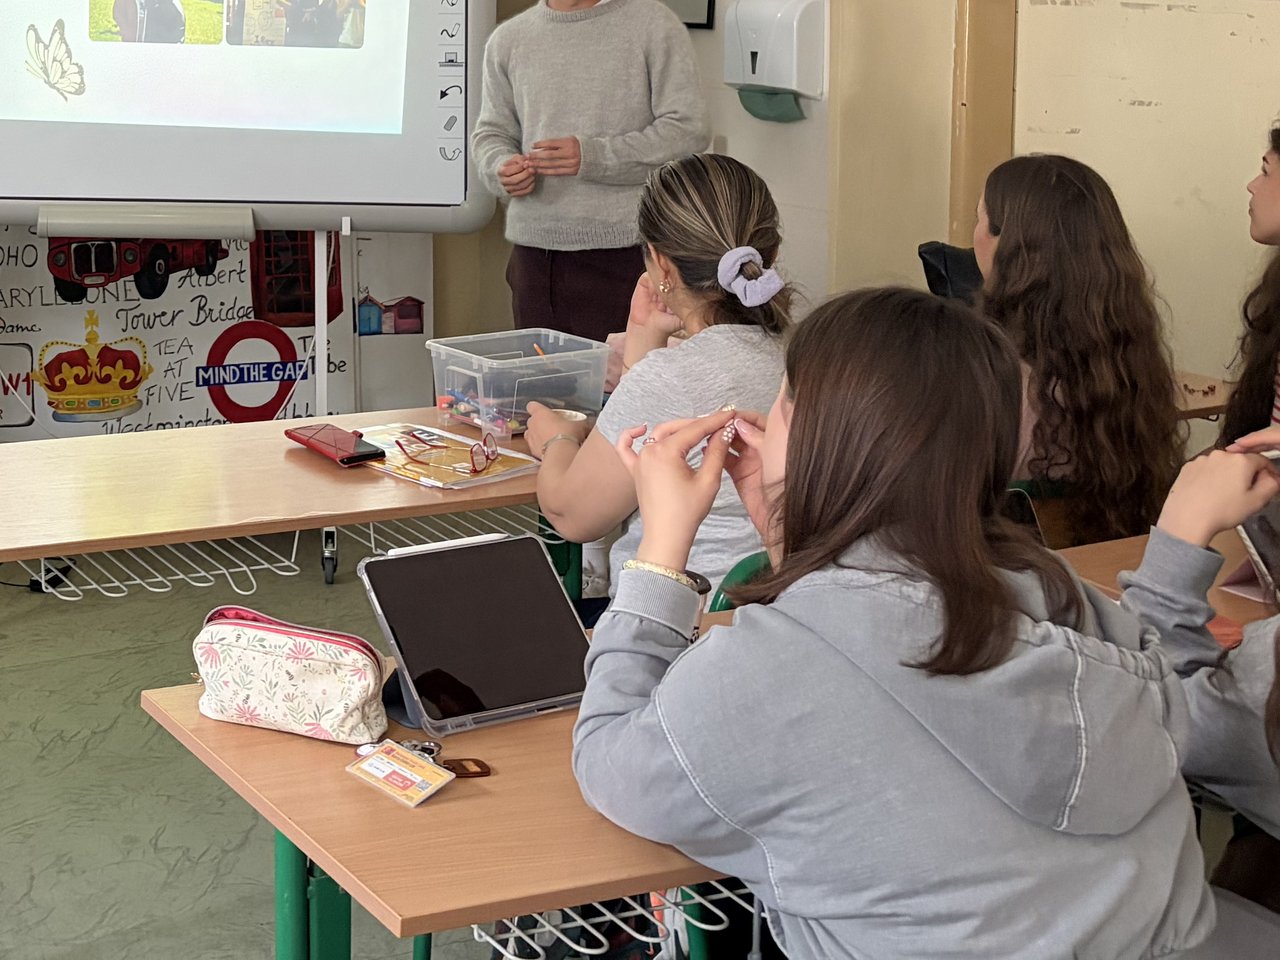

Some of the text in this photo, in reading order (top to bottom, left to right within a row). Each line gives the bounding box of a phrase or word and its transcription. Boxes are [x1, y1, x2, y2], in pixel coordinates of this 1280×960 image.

[116, 303, 185, 332] Tower
[153, 336, 194, 356] TEA
[163, 357, 189, 380] AT
[198, 361, 306, 386] MIND THE GAP
[309, 353, 347, 375] Tbe
[1, 371, 32, 396] W1
[144, 380, 196, 406] FIVE
